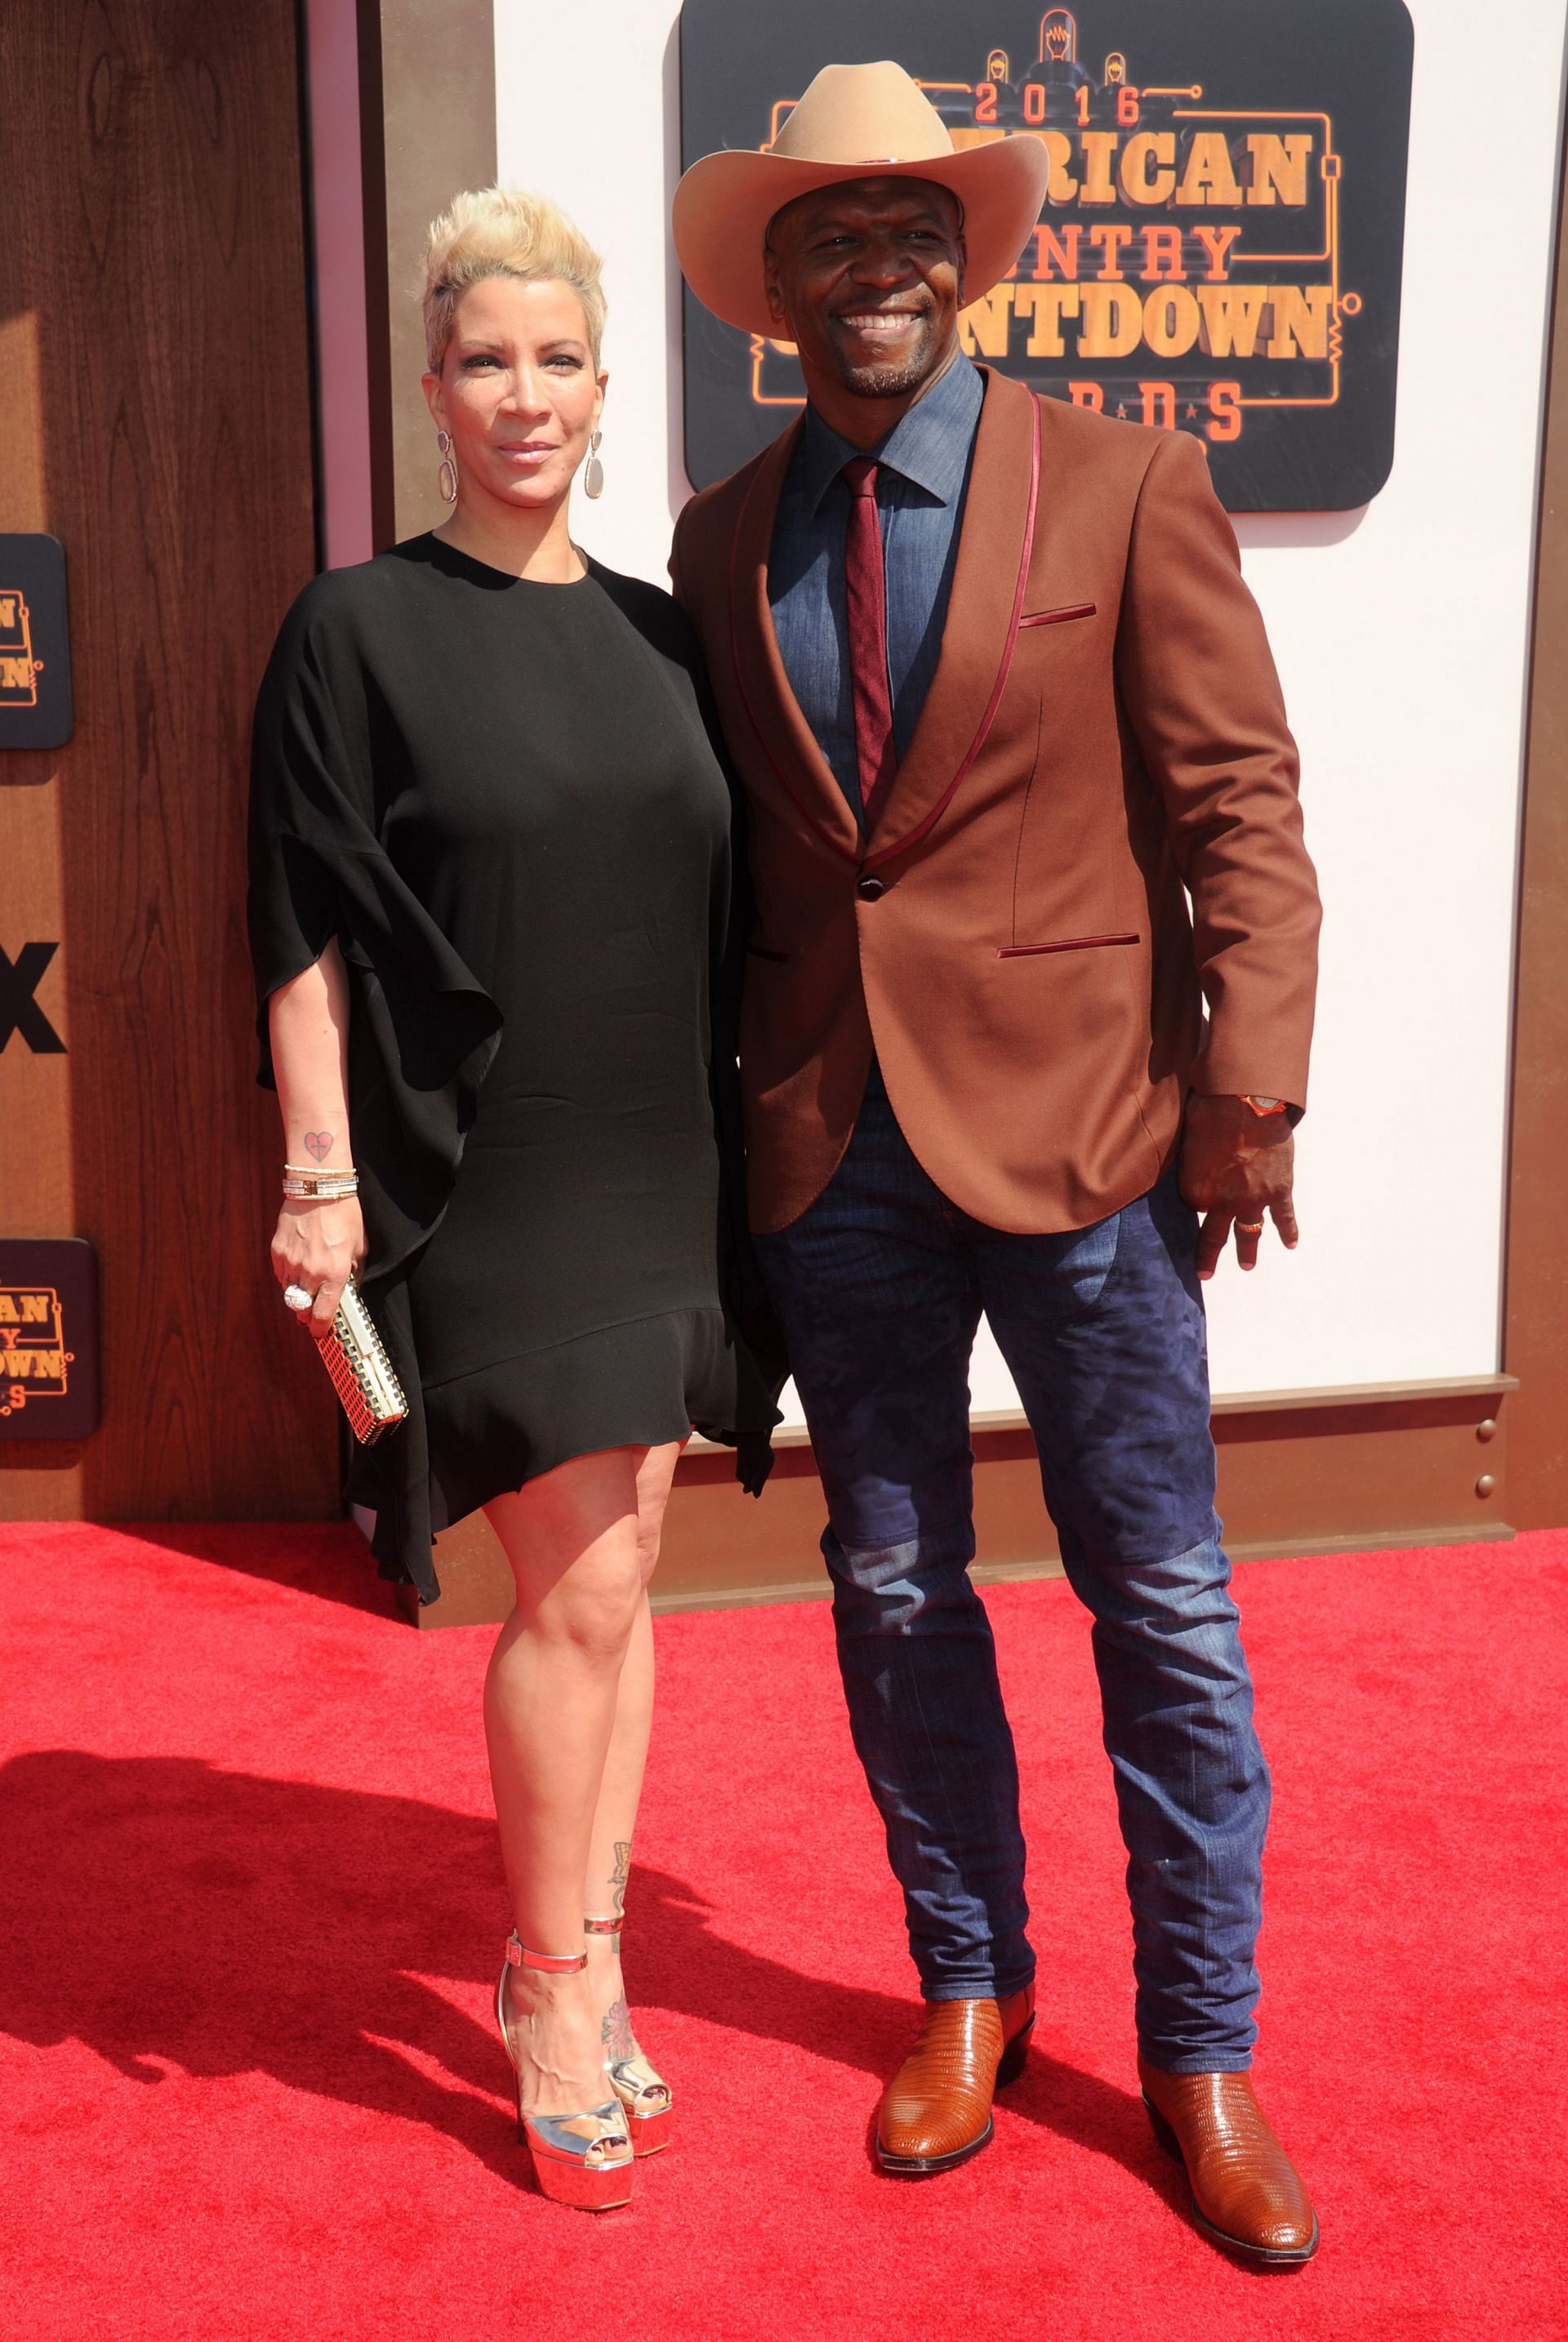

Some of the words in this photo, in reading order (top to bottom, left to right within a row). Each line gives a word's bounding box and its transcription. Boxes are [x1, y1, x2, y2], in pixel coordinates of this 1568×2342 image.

[975, 83, 1139, 125] 2016
[948, 127, 1312, 206] RICAN
[1003, 225, 1241, 280] NTRY
[957, 282, 1332, 358] NTDOWN
